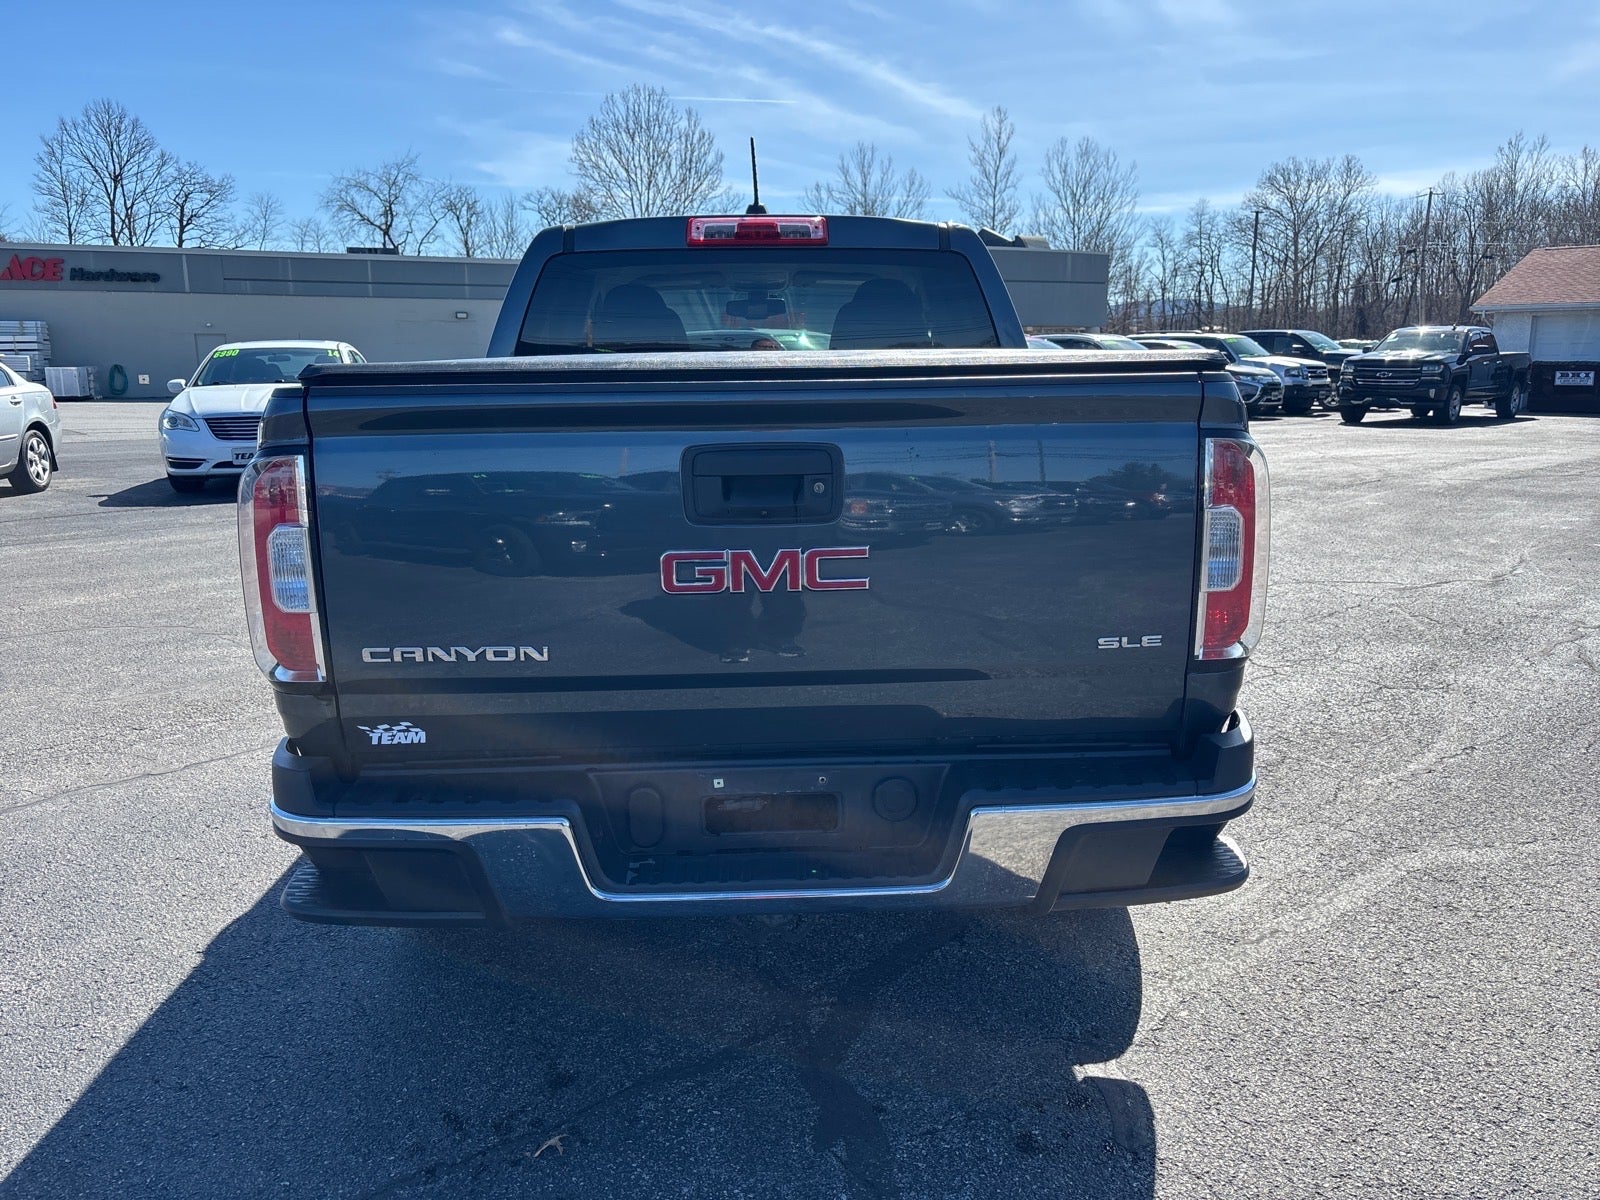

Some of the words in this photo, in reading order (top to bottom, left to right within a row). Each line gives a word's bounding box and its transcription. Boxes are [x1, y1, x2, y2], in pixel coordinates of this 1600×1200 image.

[0, 253, 64, 282] ACE
[69, 267, 161, 283] Hardware
[213, 349, 240, 359] 6990
[234, 452, 255, 460] TEA
[660, 545, 870, 594] GMC
[1097, 635, 1163, 649] SLE
[361, 645, 549, 664] CANYON
[369, 731, 427, 745] TEAM
